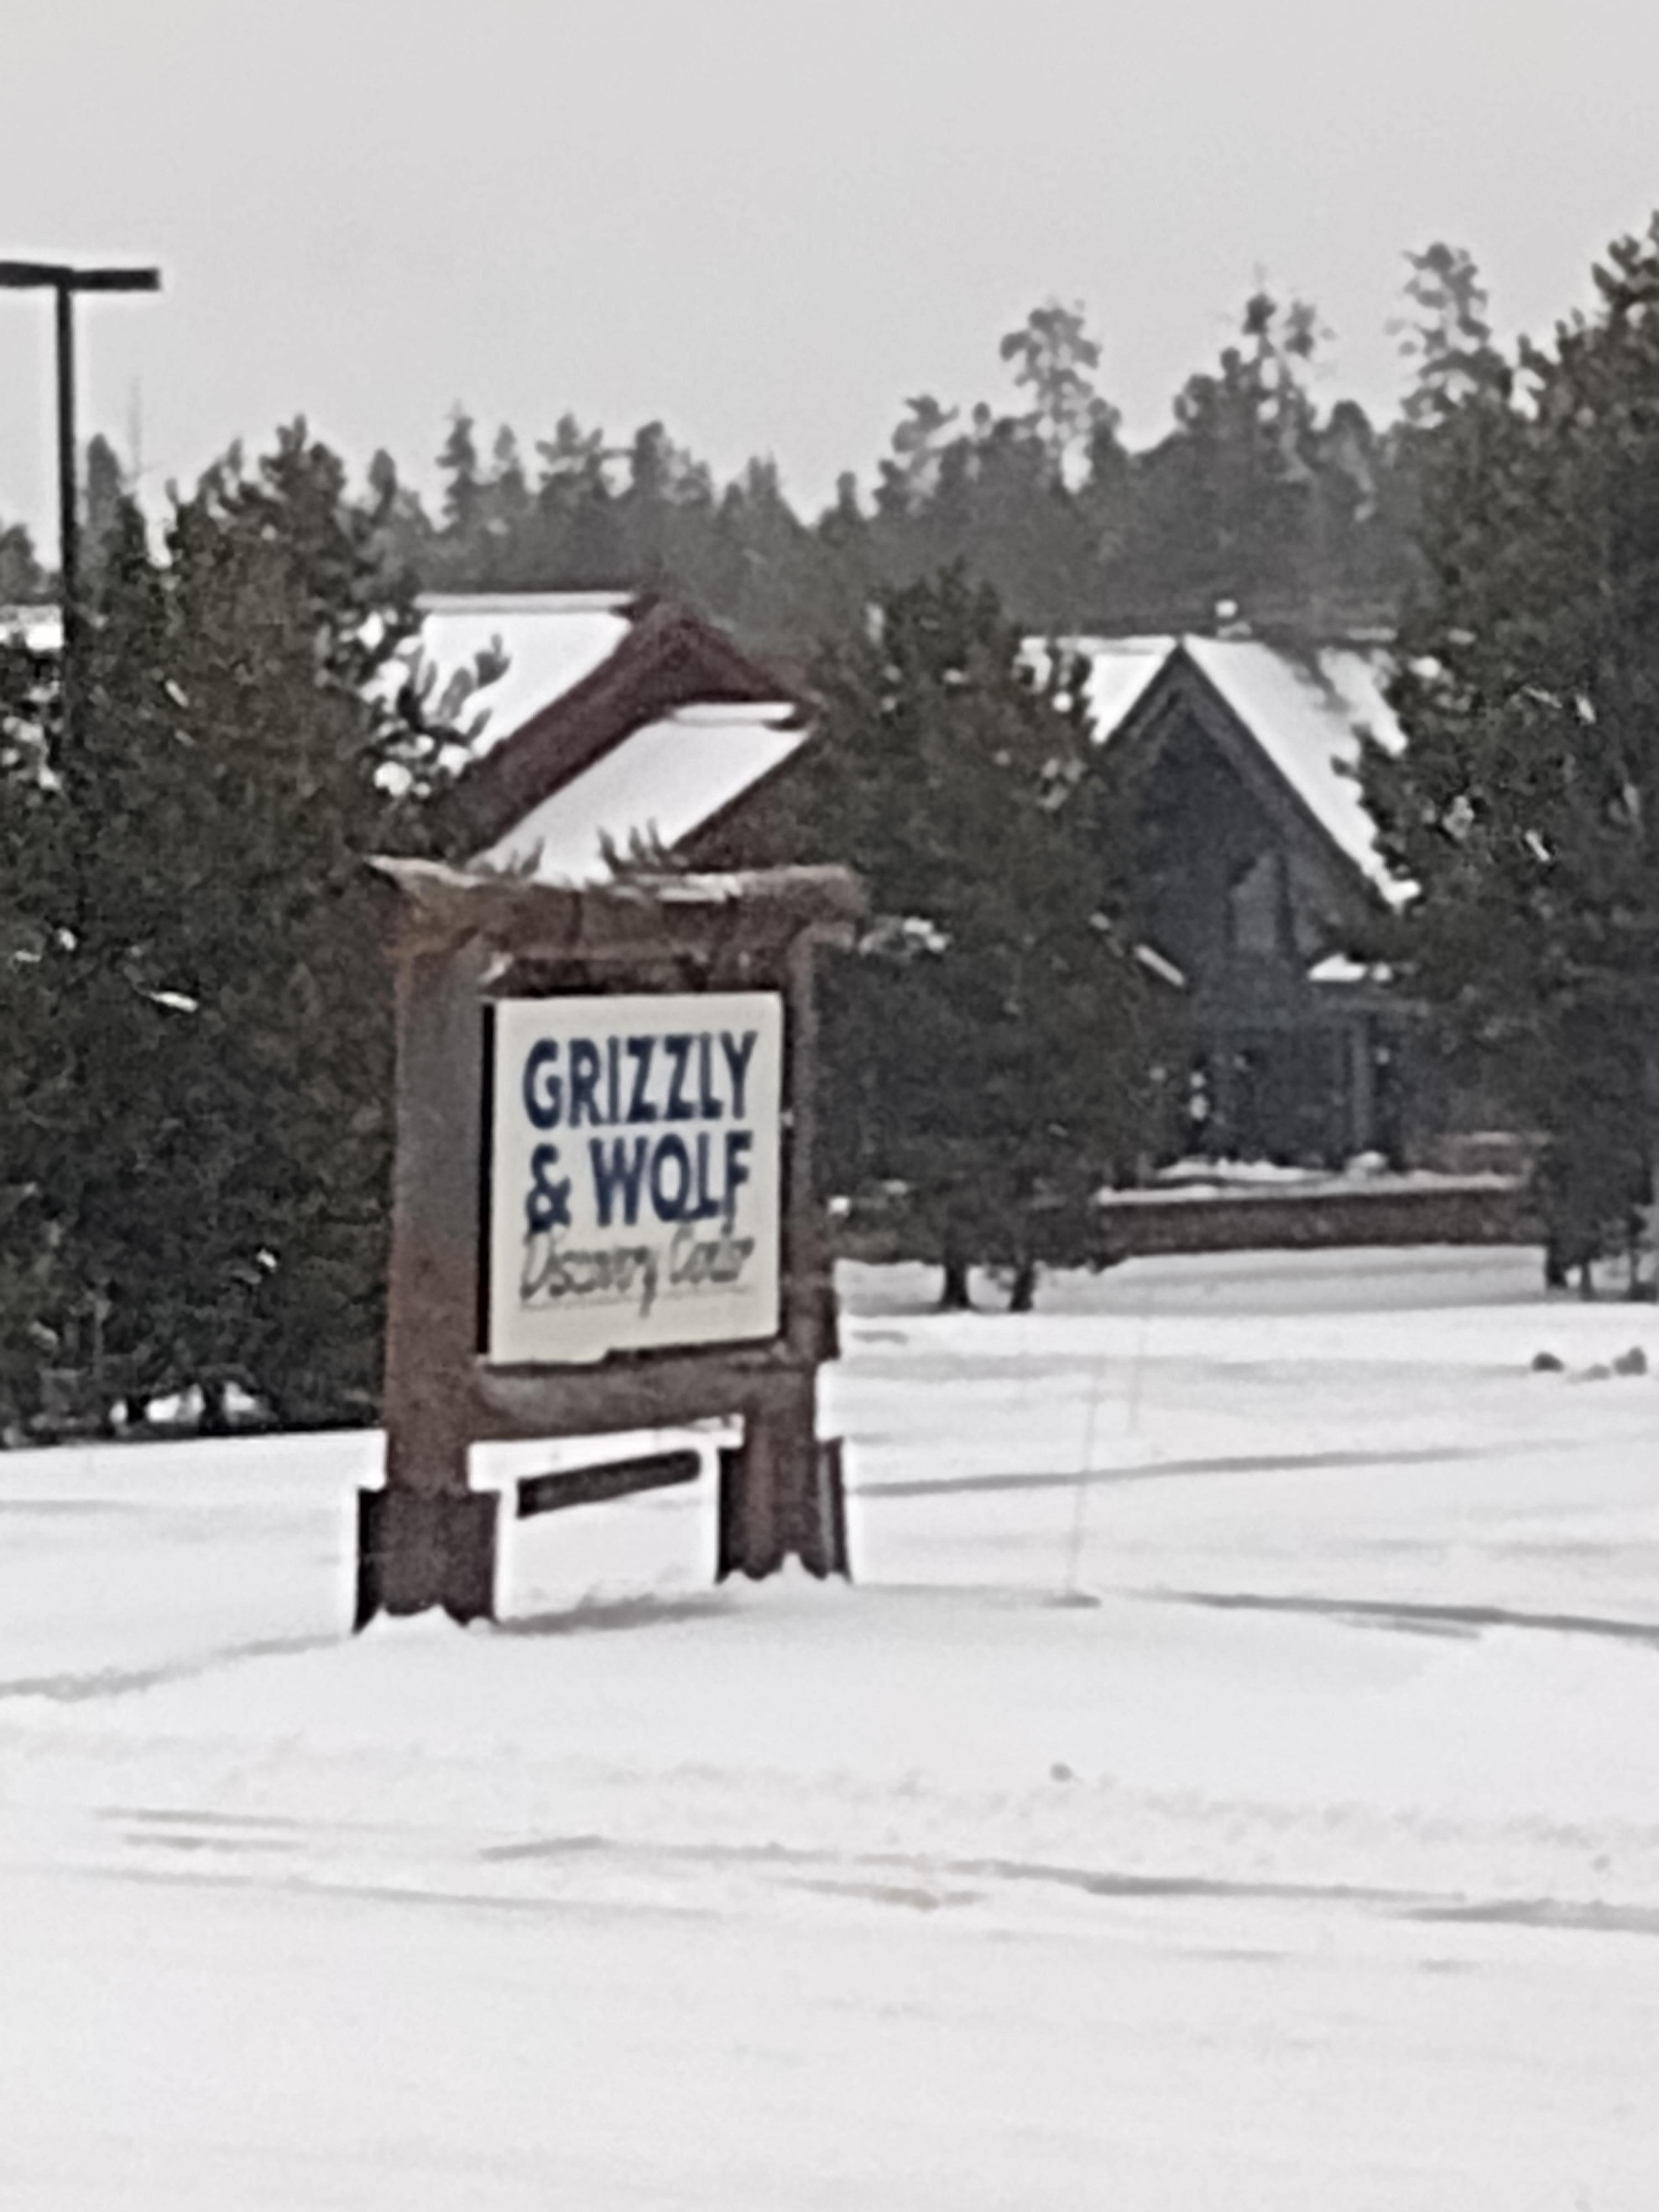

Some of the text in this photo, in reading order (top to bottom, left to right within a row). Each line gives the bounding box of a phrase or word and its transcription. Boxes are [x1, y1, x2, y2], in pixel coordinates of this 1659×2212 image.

[522, 1030, 758, 1130] GRIZZLY
[524, 1130, 753, 1233] & WOLF
